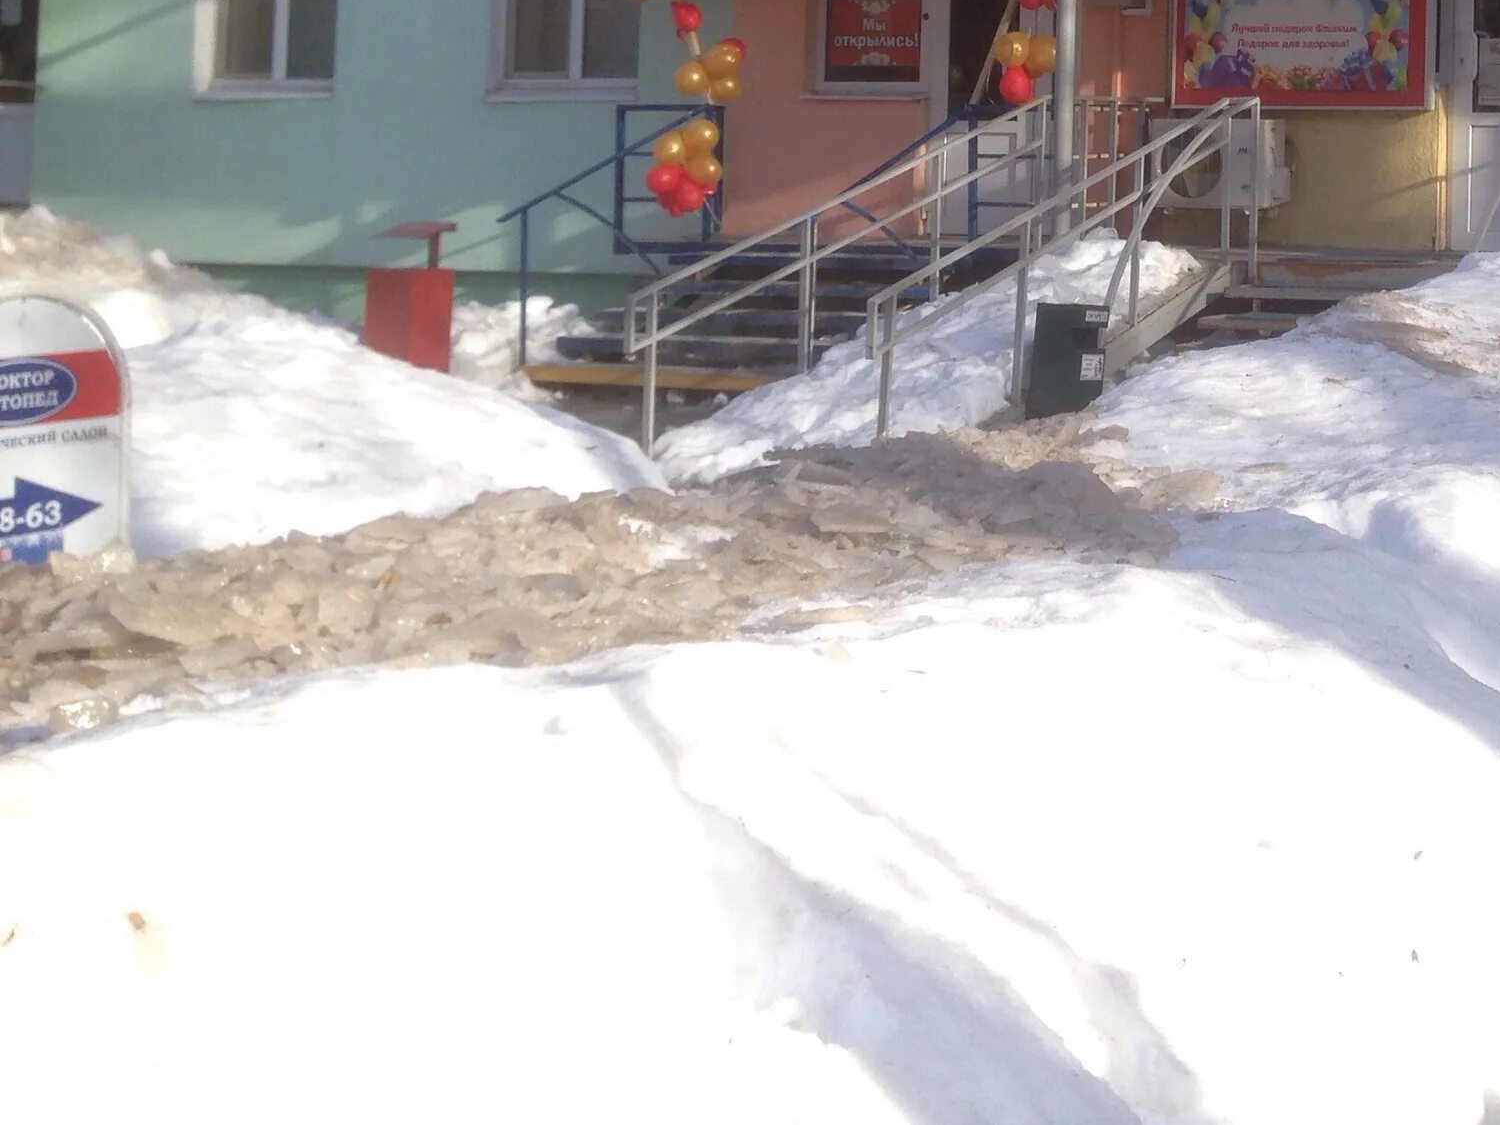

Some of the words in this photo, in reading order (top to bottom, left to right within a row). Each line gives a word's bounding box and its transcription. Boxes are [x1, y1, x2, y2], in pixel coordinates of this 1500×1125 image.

[863, 18, 886, 31] Мы
[834, 33, 918, 50] открылись!
[61, 426, 108, 443] САЛОН
